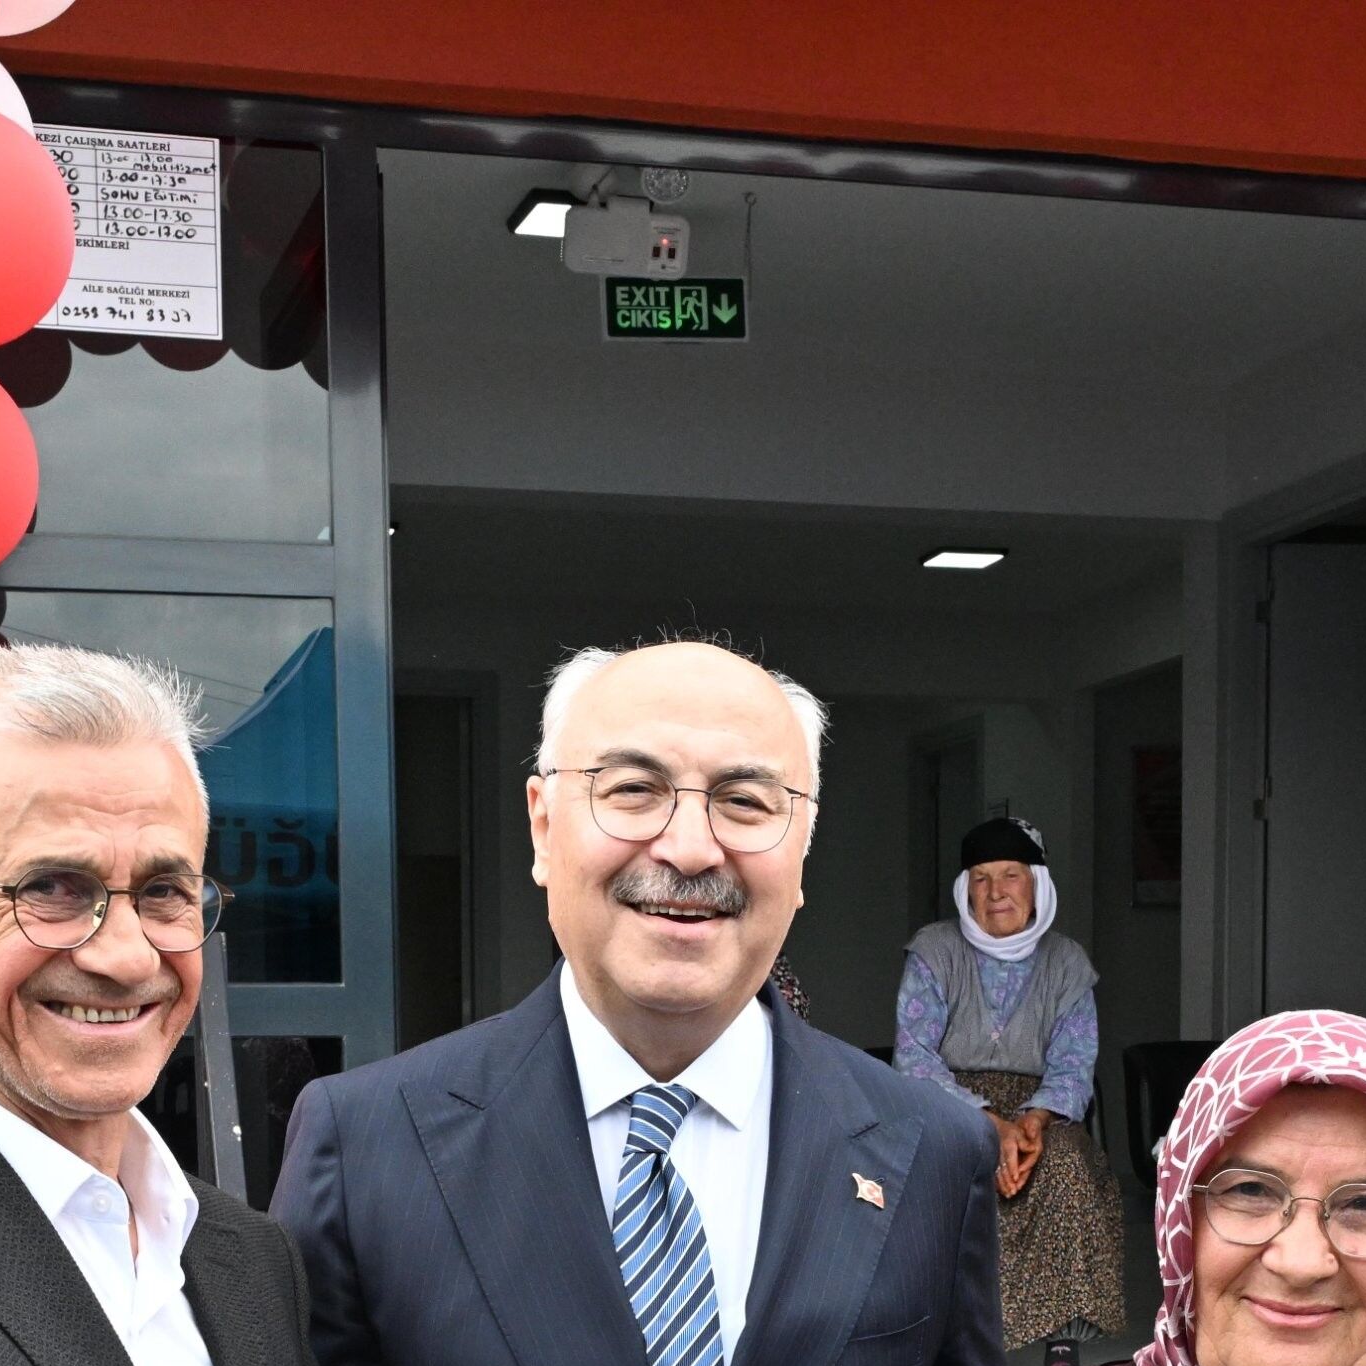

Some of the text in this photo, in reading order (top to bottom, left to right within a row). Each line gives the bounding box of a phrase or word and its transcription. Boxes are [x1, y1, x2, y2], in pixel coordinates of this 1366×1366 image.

[65, 136, 113, 148] ÇALIŞMA
[117, 140, 170, 151] SAATLERİ
[82, 284, 190, 298] AİLE SAĞLIĞI MERKEZİ
[615, 286, 671, 307] EXIT
[118, 297, 136, 305] TEL
